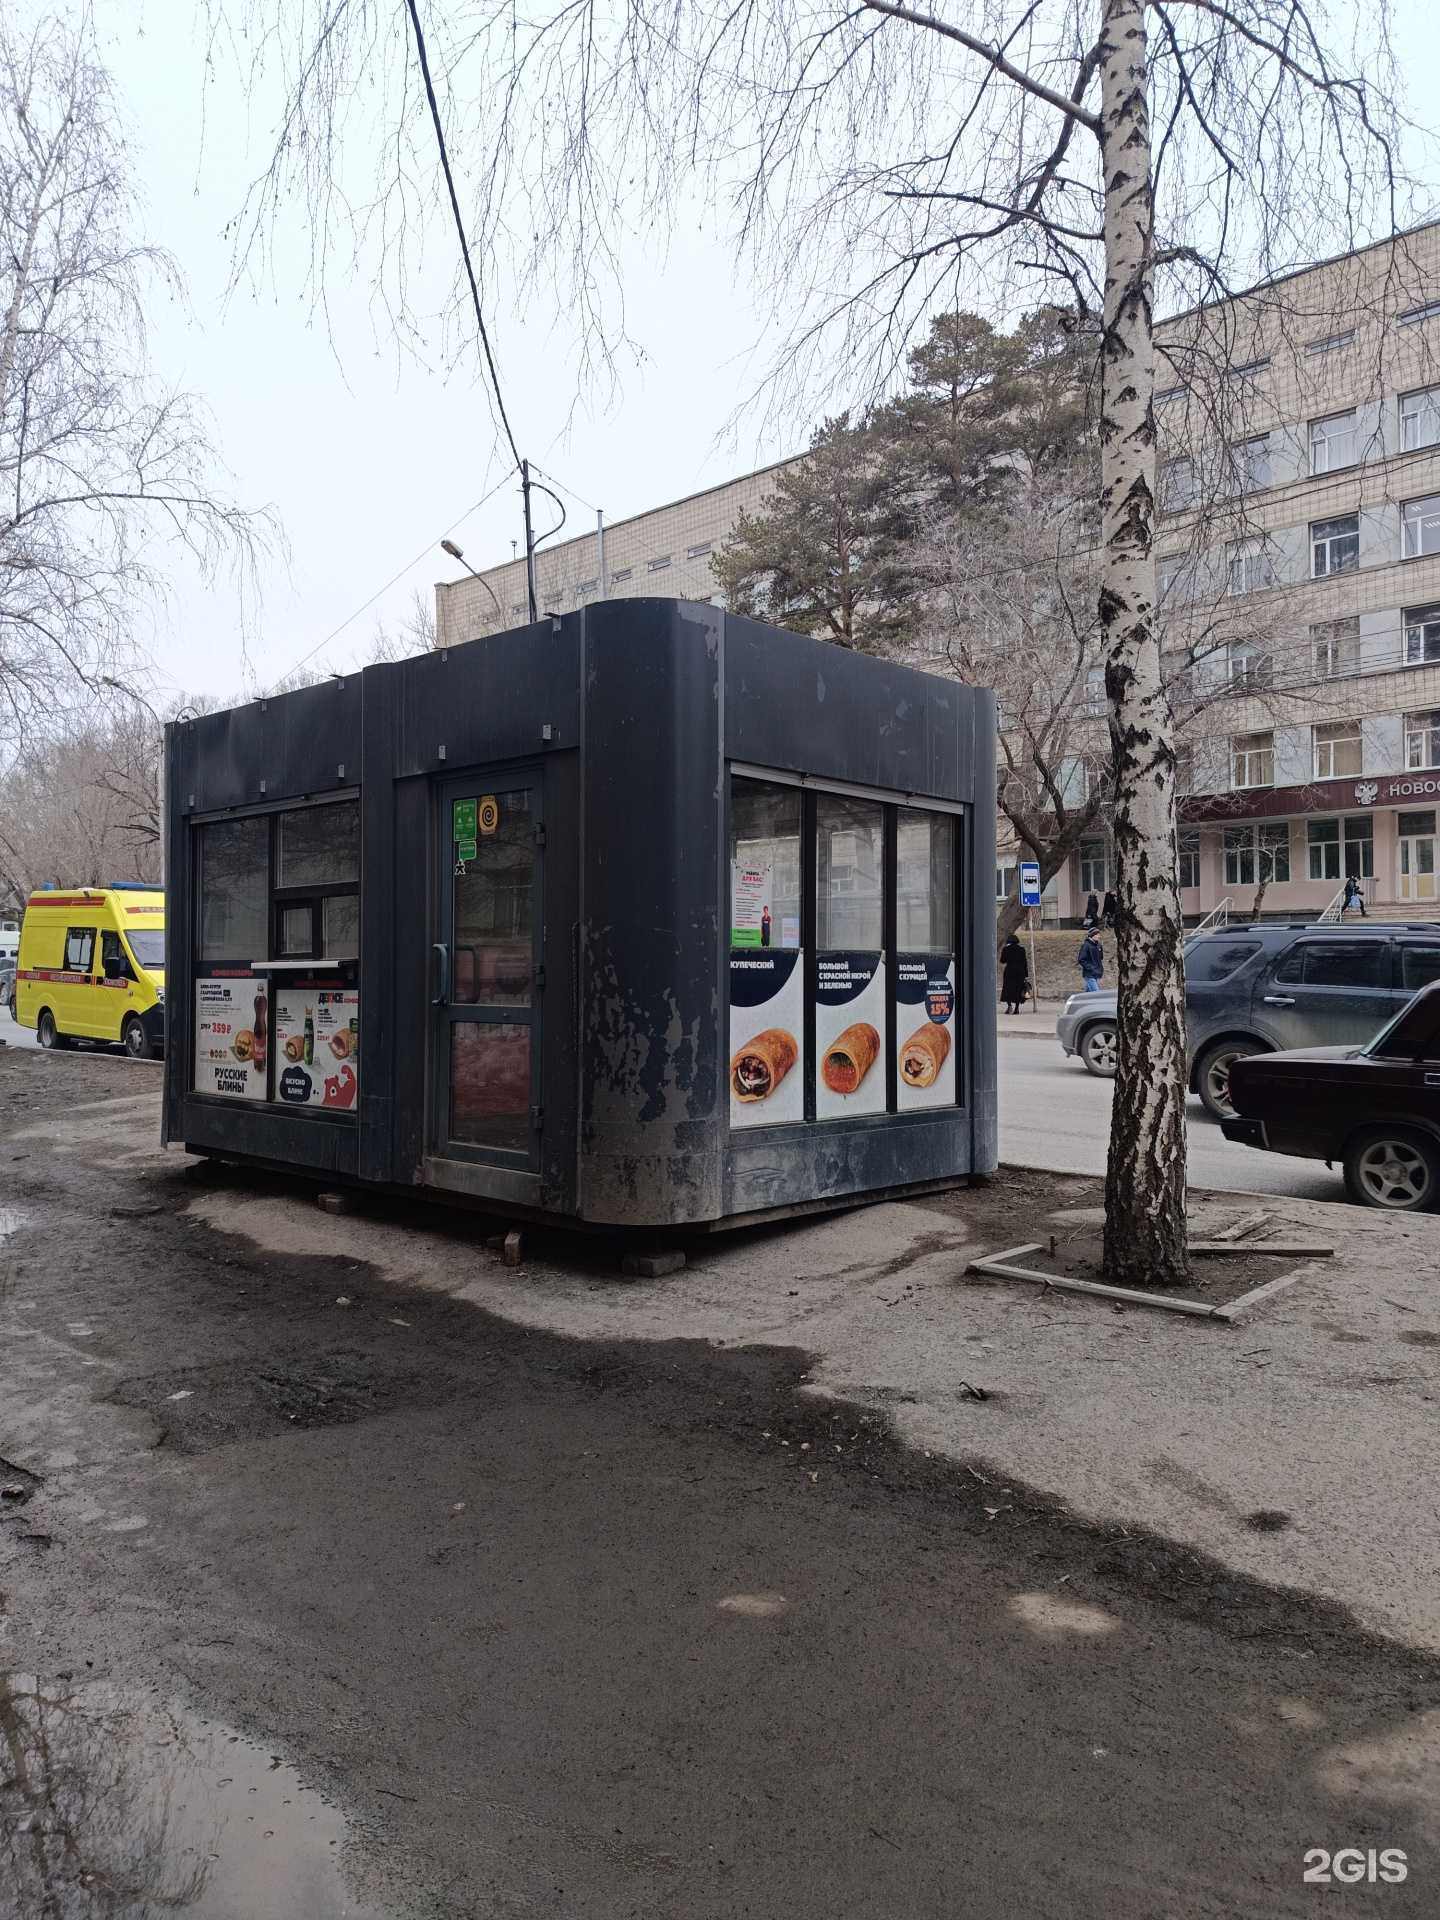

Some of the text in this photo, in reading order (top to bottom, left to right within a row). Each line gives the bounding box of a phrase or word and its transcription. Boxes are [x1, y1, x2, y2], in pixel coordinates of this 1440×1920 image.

[1389, 781, 1440, 796] НОВО
[818, 961, 848, 970] БОЛЬШОЙ
[898, 962, 925, 971] БОЛЬШОЙ
[215, 1067, 248, 1081] РУССКИЕ
[217, 1080, 245, 1094] БЛИНЫ
